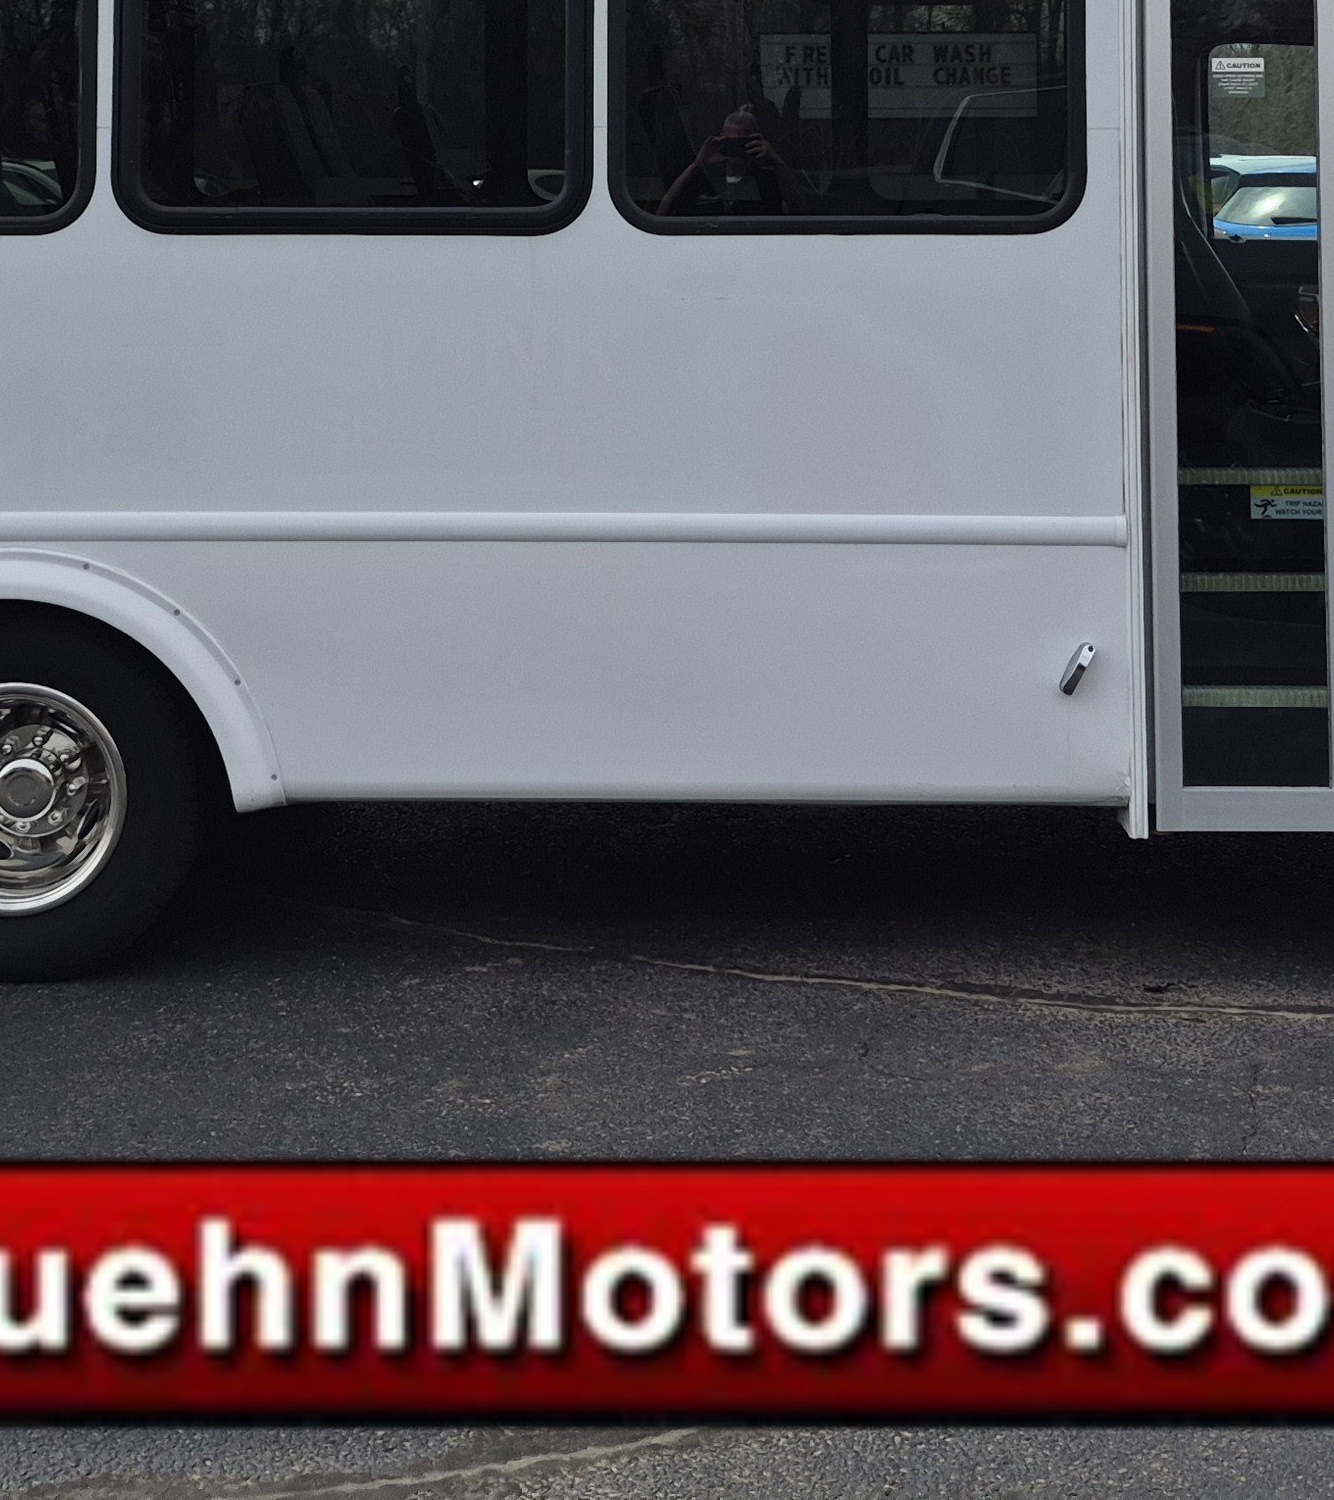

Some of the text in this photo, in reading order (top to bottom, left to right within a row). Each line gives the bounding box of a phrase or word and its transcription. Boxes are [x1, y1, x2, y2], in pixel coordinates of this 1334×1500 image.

[785, 45, 992, 63] FRE CAR WASH
[869, 67, 905, 86] OIL
[933, 67, 1012, 86] CHANGE
